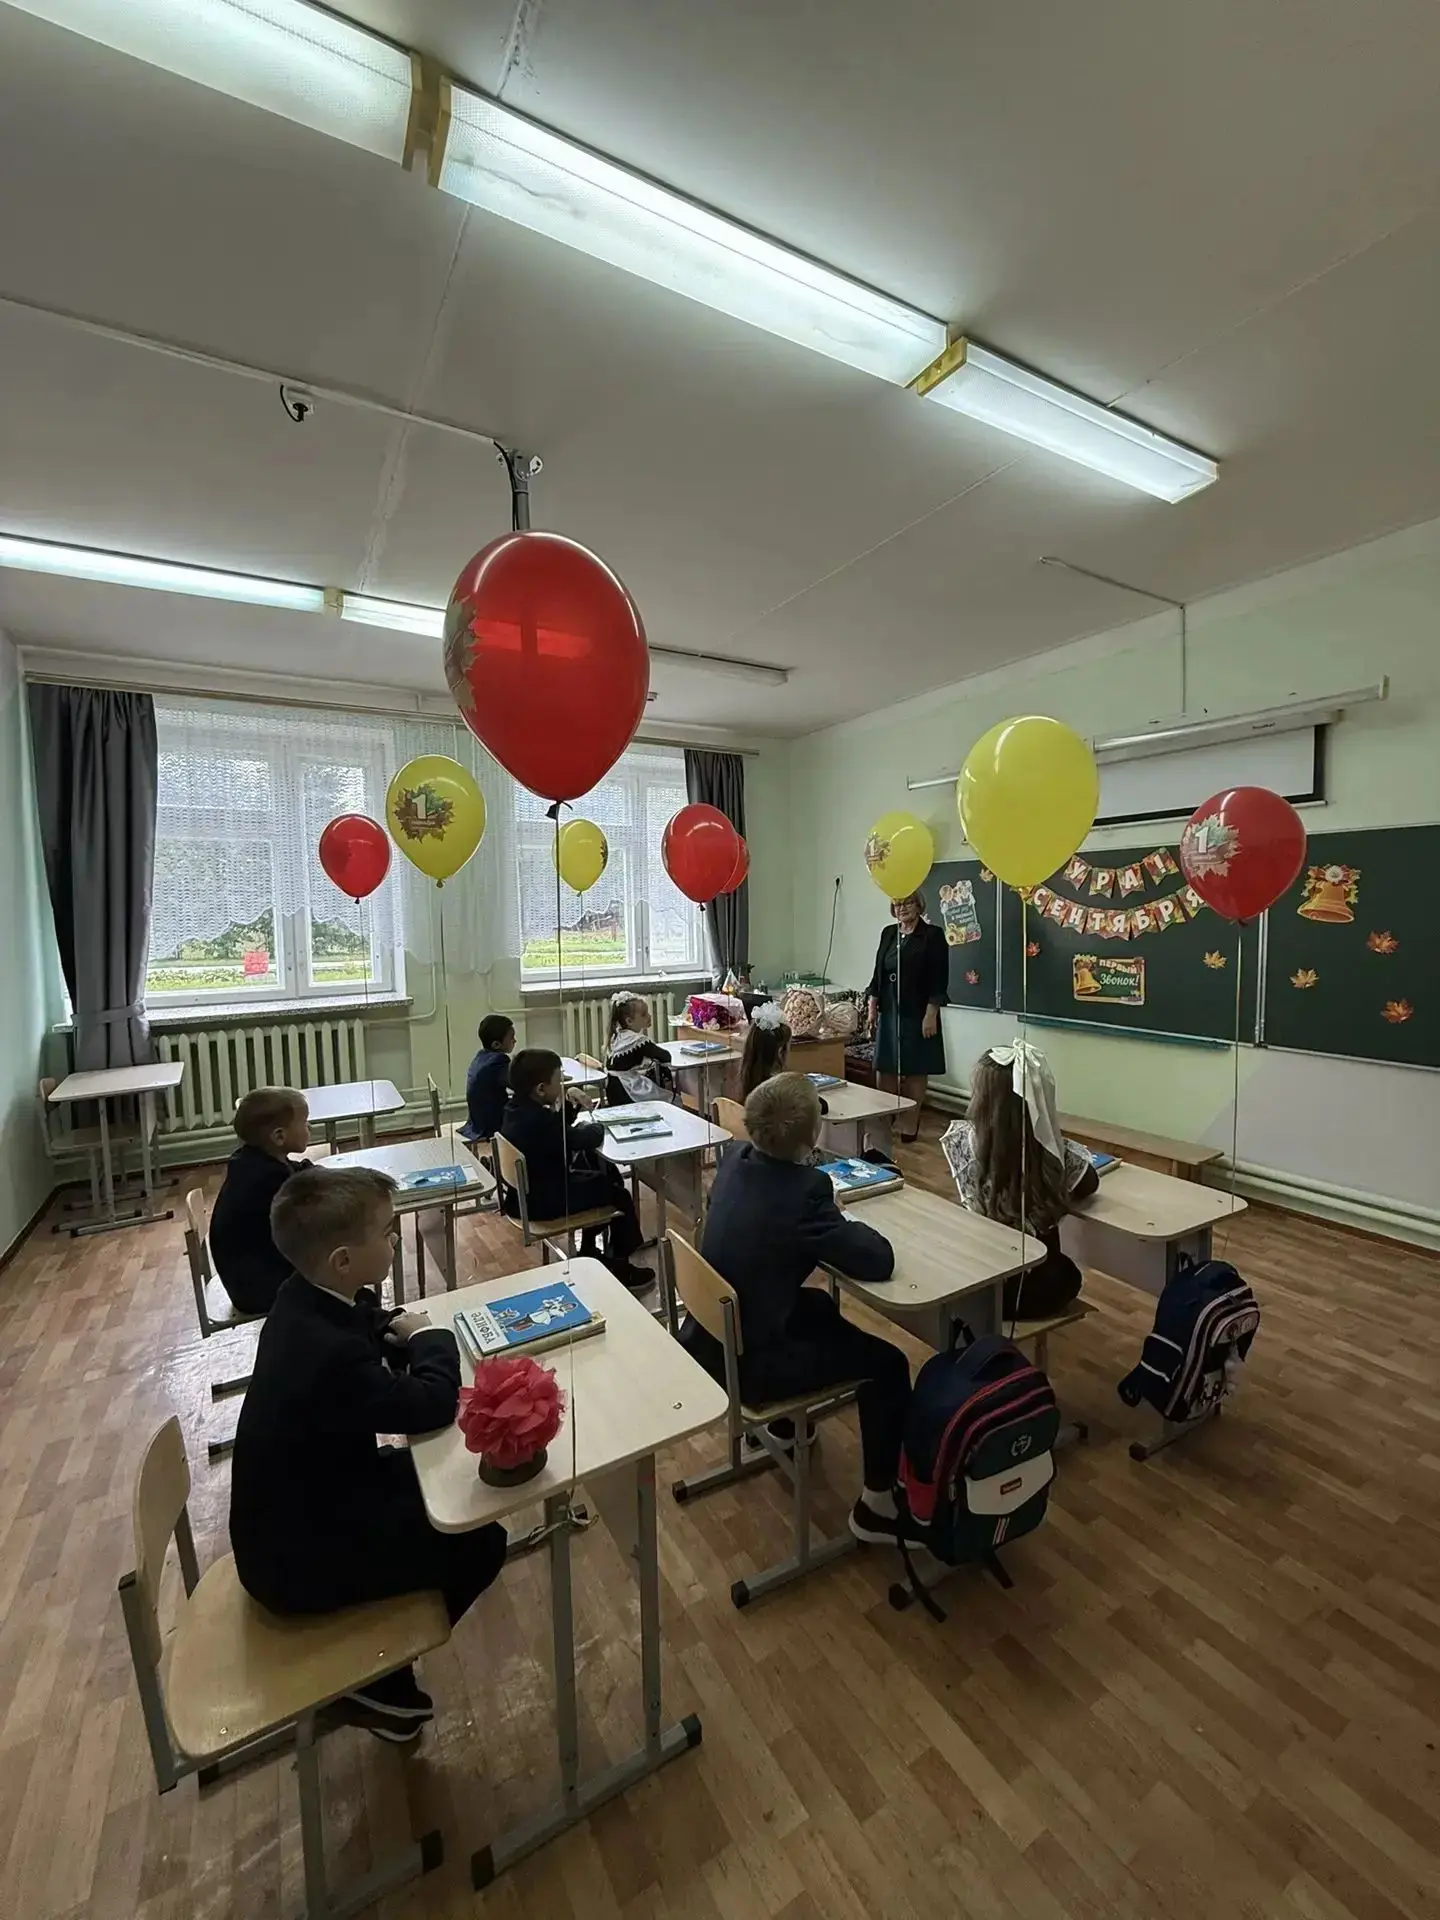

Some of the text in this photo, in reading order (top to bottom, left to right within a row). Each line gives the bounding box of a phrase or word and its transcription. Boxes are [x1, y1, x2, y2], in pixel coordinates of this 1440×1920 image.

[412, 794, 426, 819] 1
[1195, 826, 1209, 853] 1
[1033, 887, 1205, 933] СЕНТЯБРЯ
